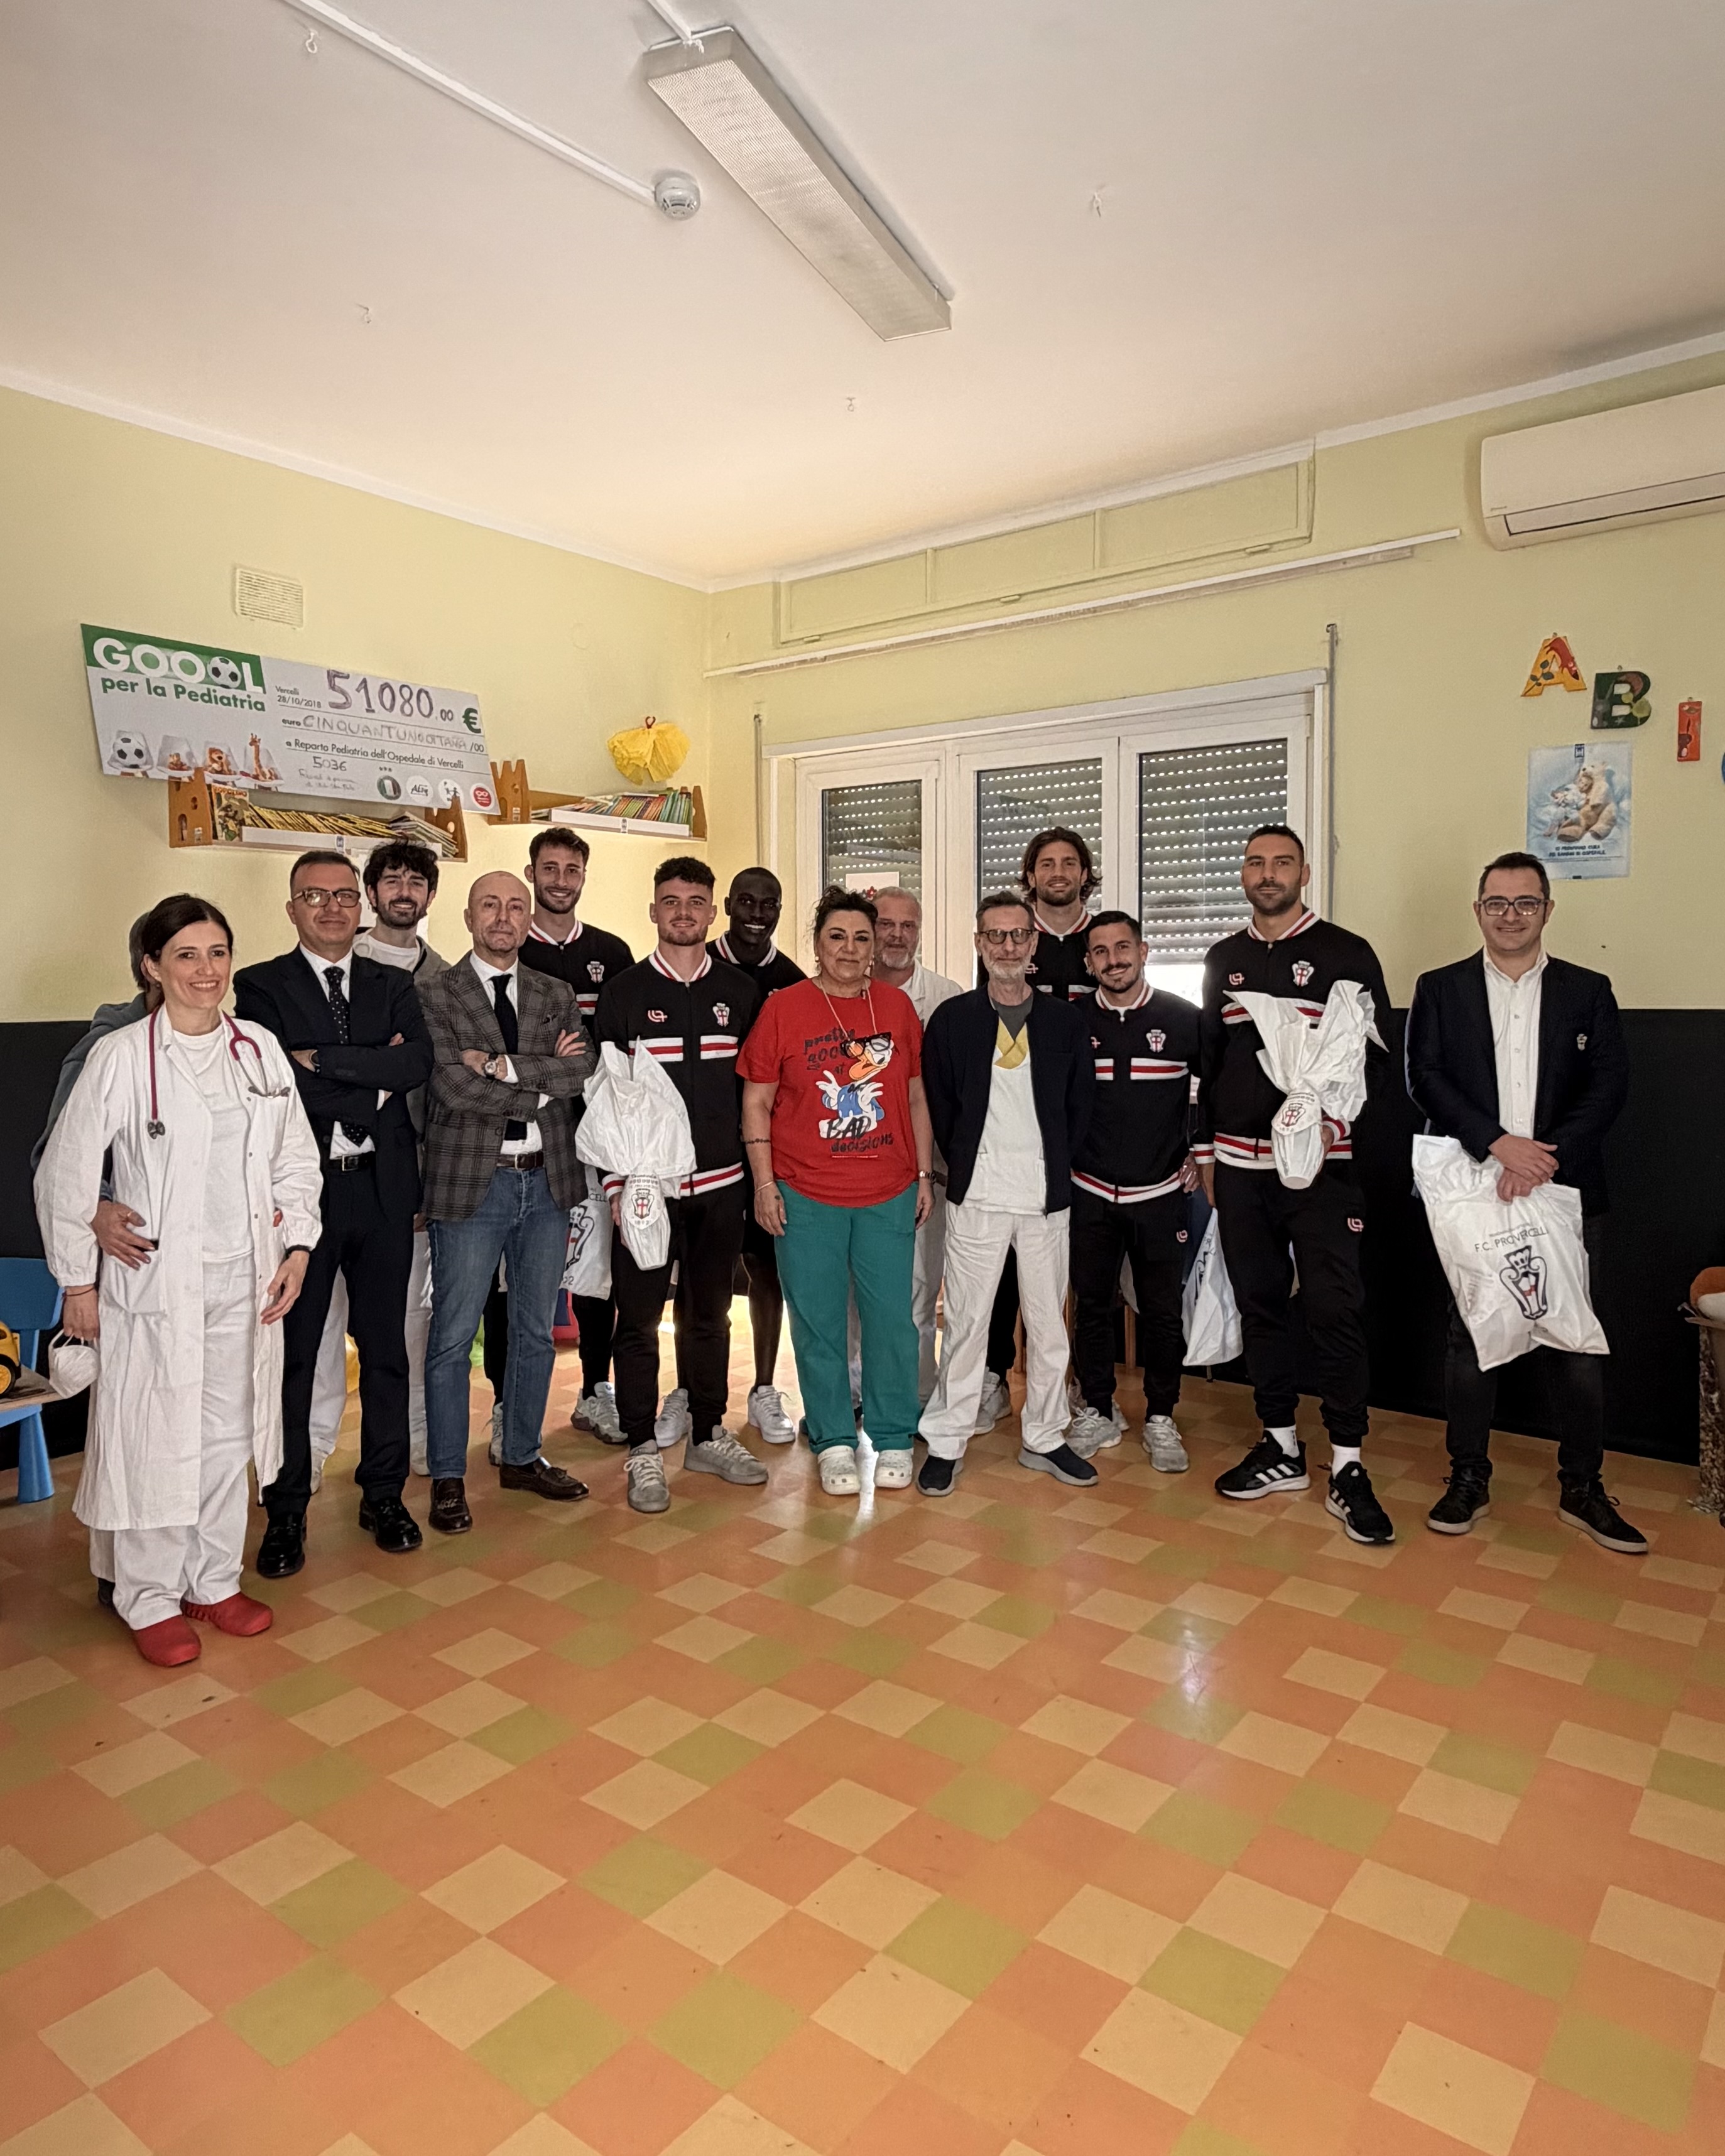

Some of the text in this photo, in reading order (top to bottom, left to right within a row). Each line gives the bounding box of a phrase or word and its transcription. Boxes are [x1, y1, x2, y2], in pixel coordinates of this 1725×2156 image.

[93, 637, 264, 693] GOOOL
[101, 677, 266, 712] per la Pediatria
[275, 685, 300, 695] Vercelli
[277, 695, 322, 708] 28/10/2018
[281, 718, 302, 727] euro
[295, 738, 329, 752] Reparto
[331, 743, 369, 757] Pediatria
[371, 748, 425, 764] dell'Ospedale
[427, 756, 435, 766] di
[437, 757, 464, 769] Vercelli
[312, 756, 347, 771] 5036
[826, 1115, 872, 1140] BAD
